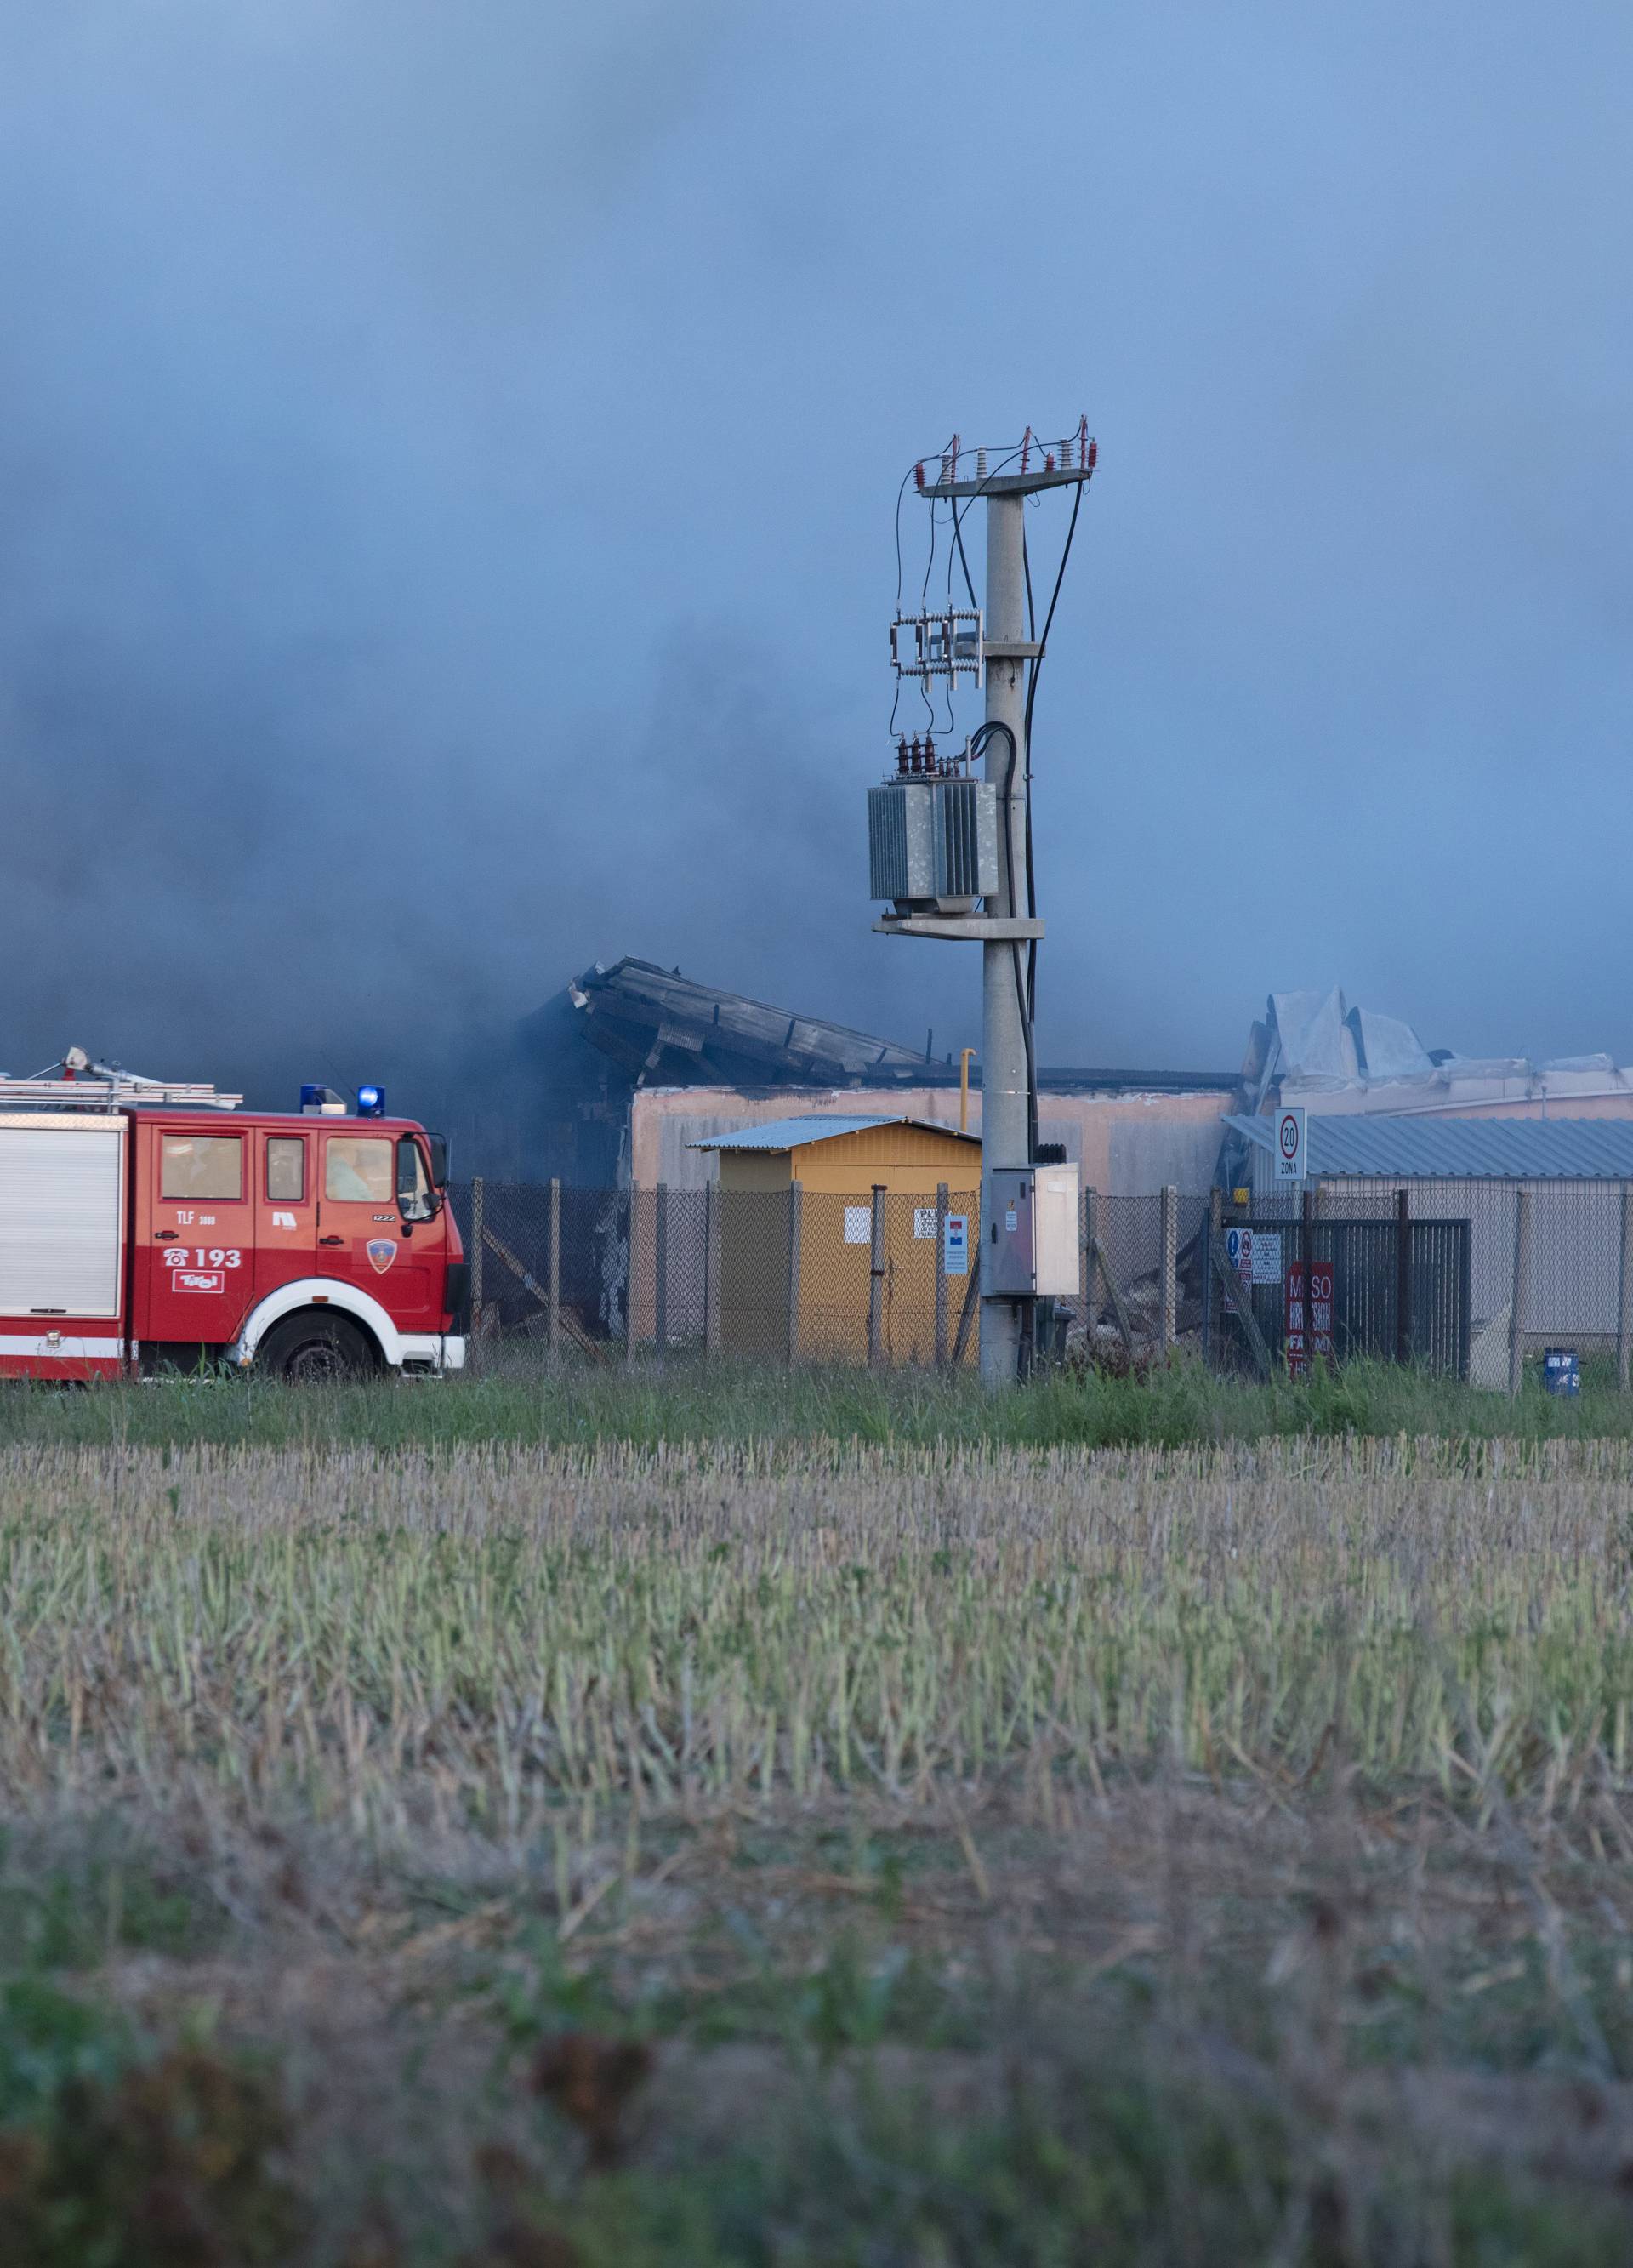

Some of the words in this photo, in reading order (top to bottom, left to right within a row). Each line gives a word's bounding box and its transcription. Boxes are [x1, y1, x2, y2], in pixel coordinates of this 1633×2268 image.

[1284, 1127, 1294, 1147] 20
[1281, 1162, 1297, 1174] ZONA
[177, 1211, 195, 1225] TLF
[195, 1248, 241, 1268] 193
[1289, 1275, 1332, 1299] MSO
